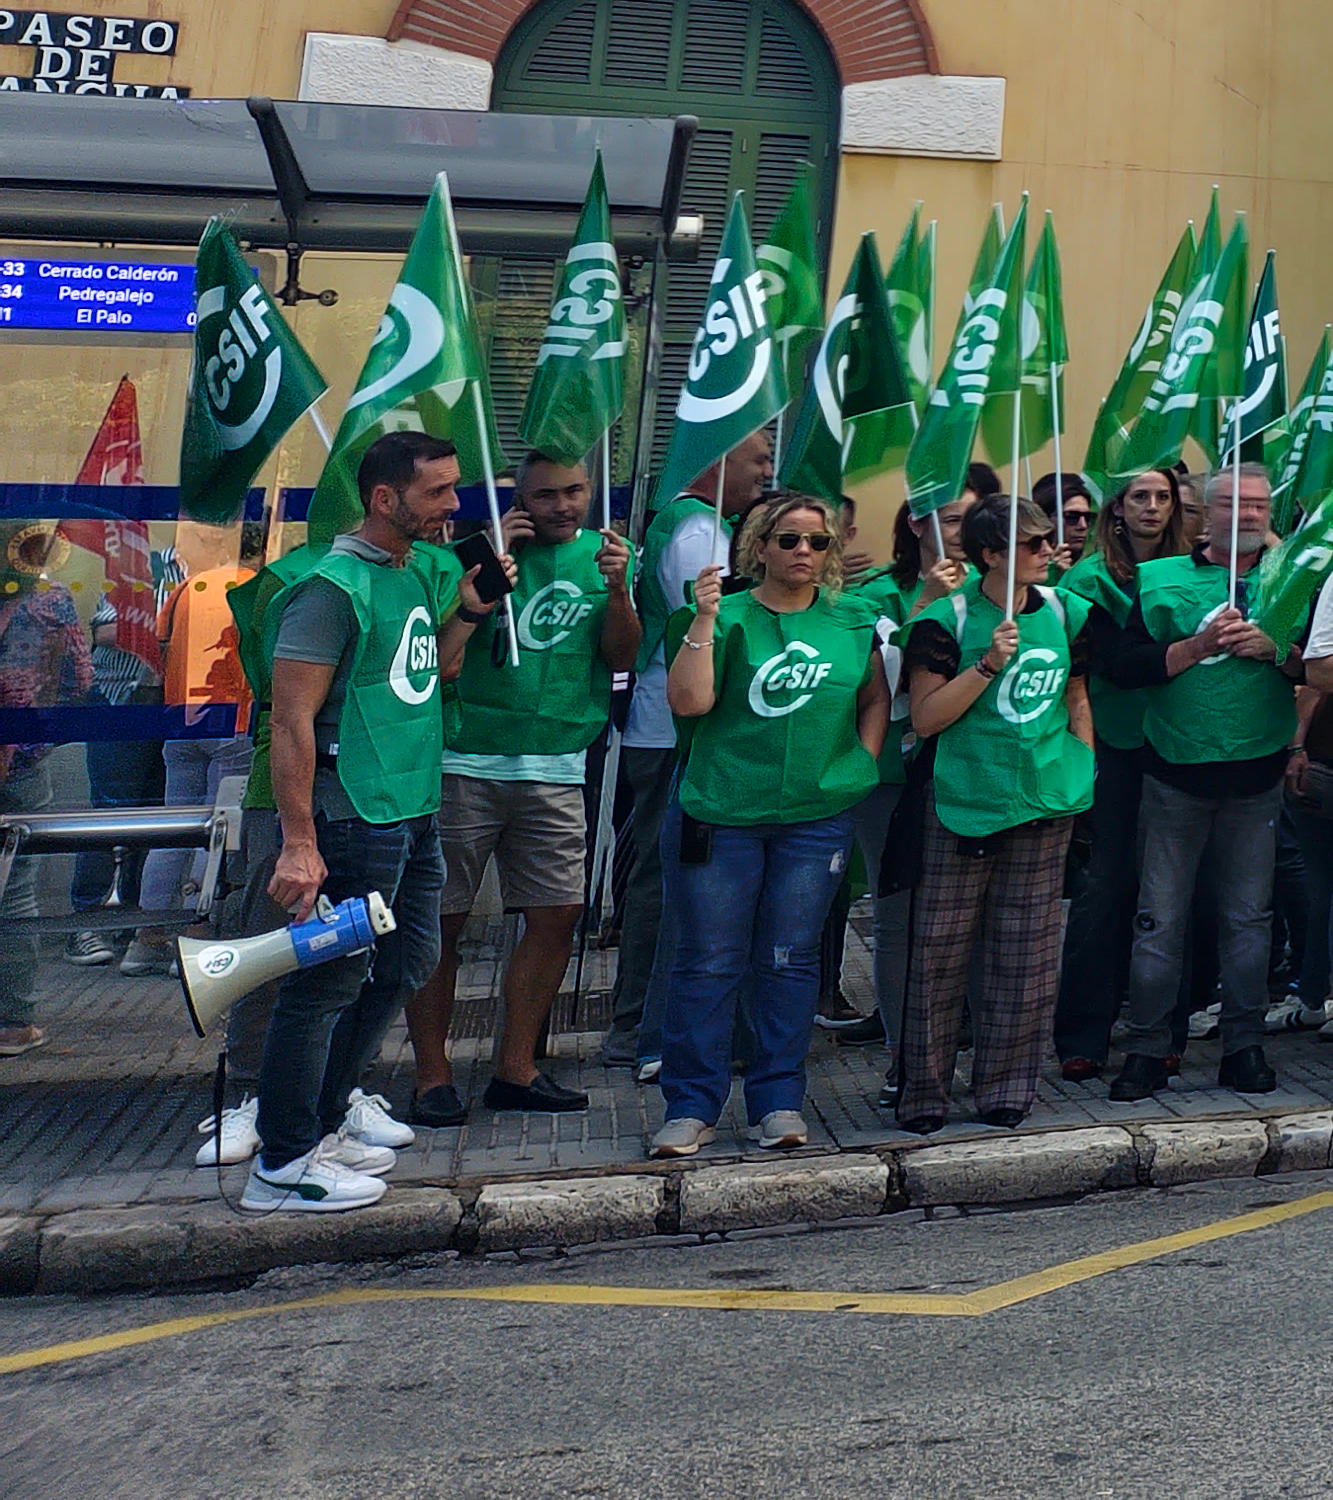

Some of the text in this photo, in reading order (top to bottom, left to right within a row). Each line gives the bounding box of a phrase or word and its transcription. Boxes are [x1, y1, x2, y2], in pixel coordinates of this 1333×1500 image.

[35, 46, 110, 81] DE
[39, 263, 103, 279] Cerrado
[106, 265, 179, 282] Calderón
[59, 286, 154, 306] Pedregalejo
[77, 308, 92, 323] El
[96, 310, 133, 324] Palo
[204, 283, 272, 411] CSIF
[533, 599, 593, 628] CSIF
[767, 661, 832, 692] CSIF
[1014, 665, 1065, 700] CSIF
